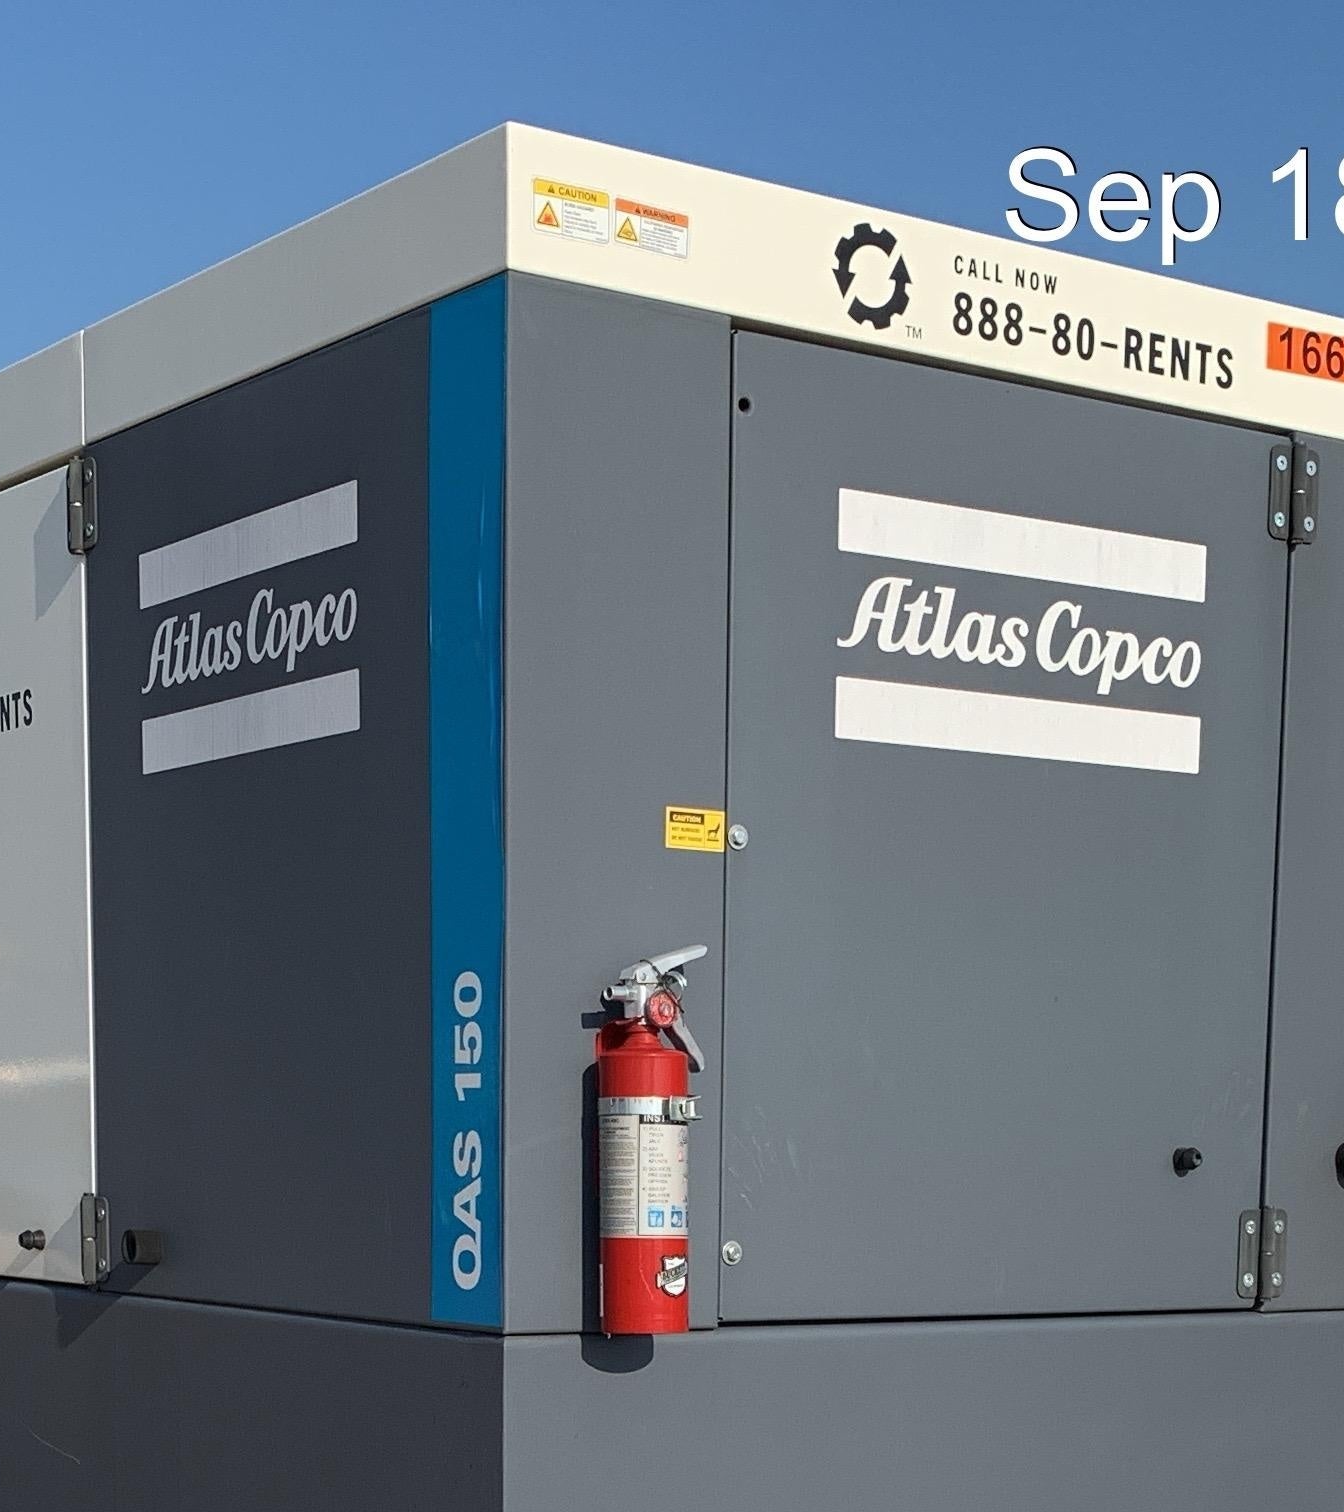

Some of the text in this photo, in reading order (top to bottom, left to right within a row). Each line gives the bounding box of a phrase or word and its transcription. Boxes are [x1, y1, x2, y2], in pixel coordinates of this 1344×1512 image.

[558, 186, 598, 203] CAUTION
[641, 207, 677, 223] WARNING
[953, 255, 1059, 296] CALL NOW
[952, 291, 1235, 390] 888-80-RENTS
[140, 587, 358, 695] Atlas Copco
[836, 576, 1202, 696] Atlas Copco
[453, 970, 483, 1102] 150
